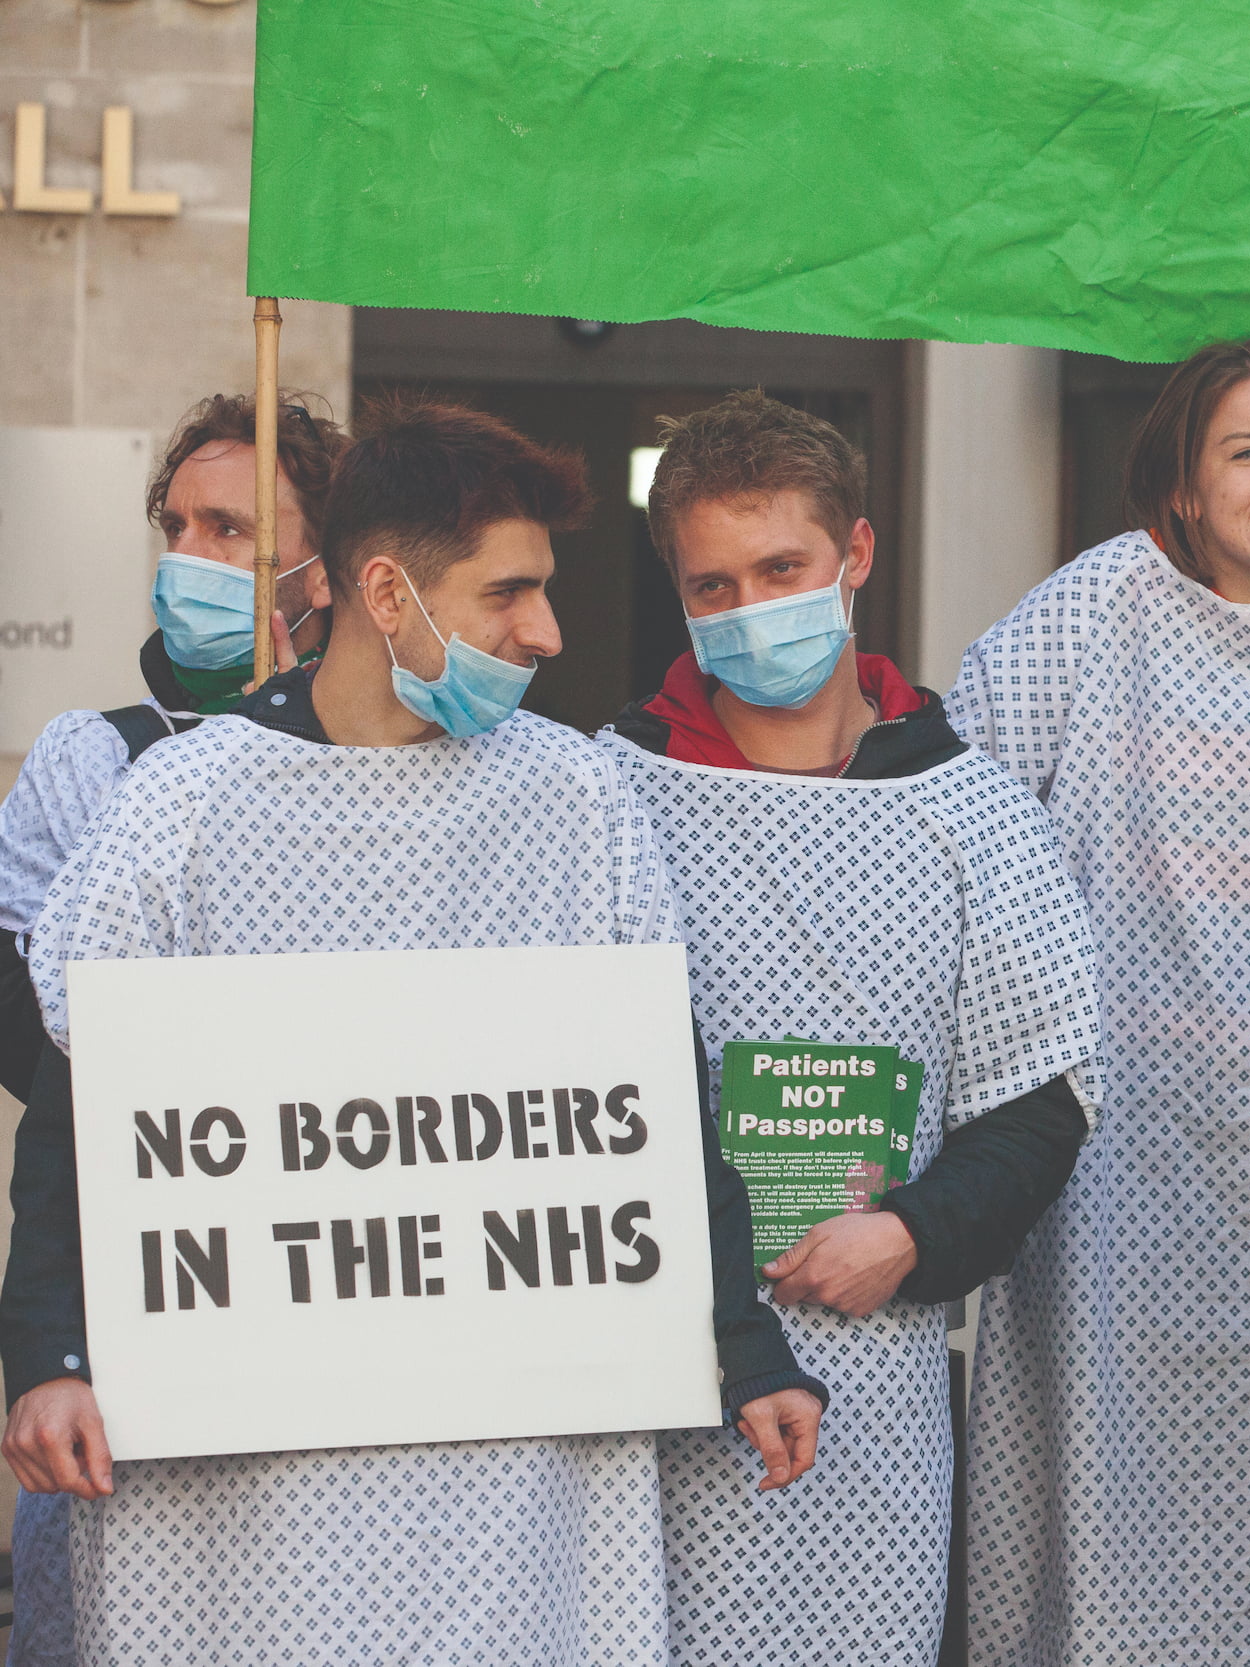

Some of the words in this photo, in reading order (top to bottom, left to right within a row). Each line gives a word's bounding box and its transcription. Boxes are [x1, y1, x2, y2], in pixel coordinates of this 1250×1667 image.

[0, 102, 182, 216] LL
[753, 1054, 876, 1076] Patients
[781, 1085, 845, 1108] NOT
[135, 1107, 246, 1178] NO
[280, 1084, 647, 1171] BORDERS
[738, 1113, 885, 1140] Passports
[751, 1151, 766, 1159] April
[778, 1151, 813, 1159] government
[142, 1228, 229, 1312] IN
[273, 1215, 445, 1302] THE
[483, 1201, 660, 1290] NHS
